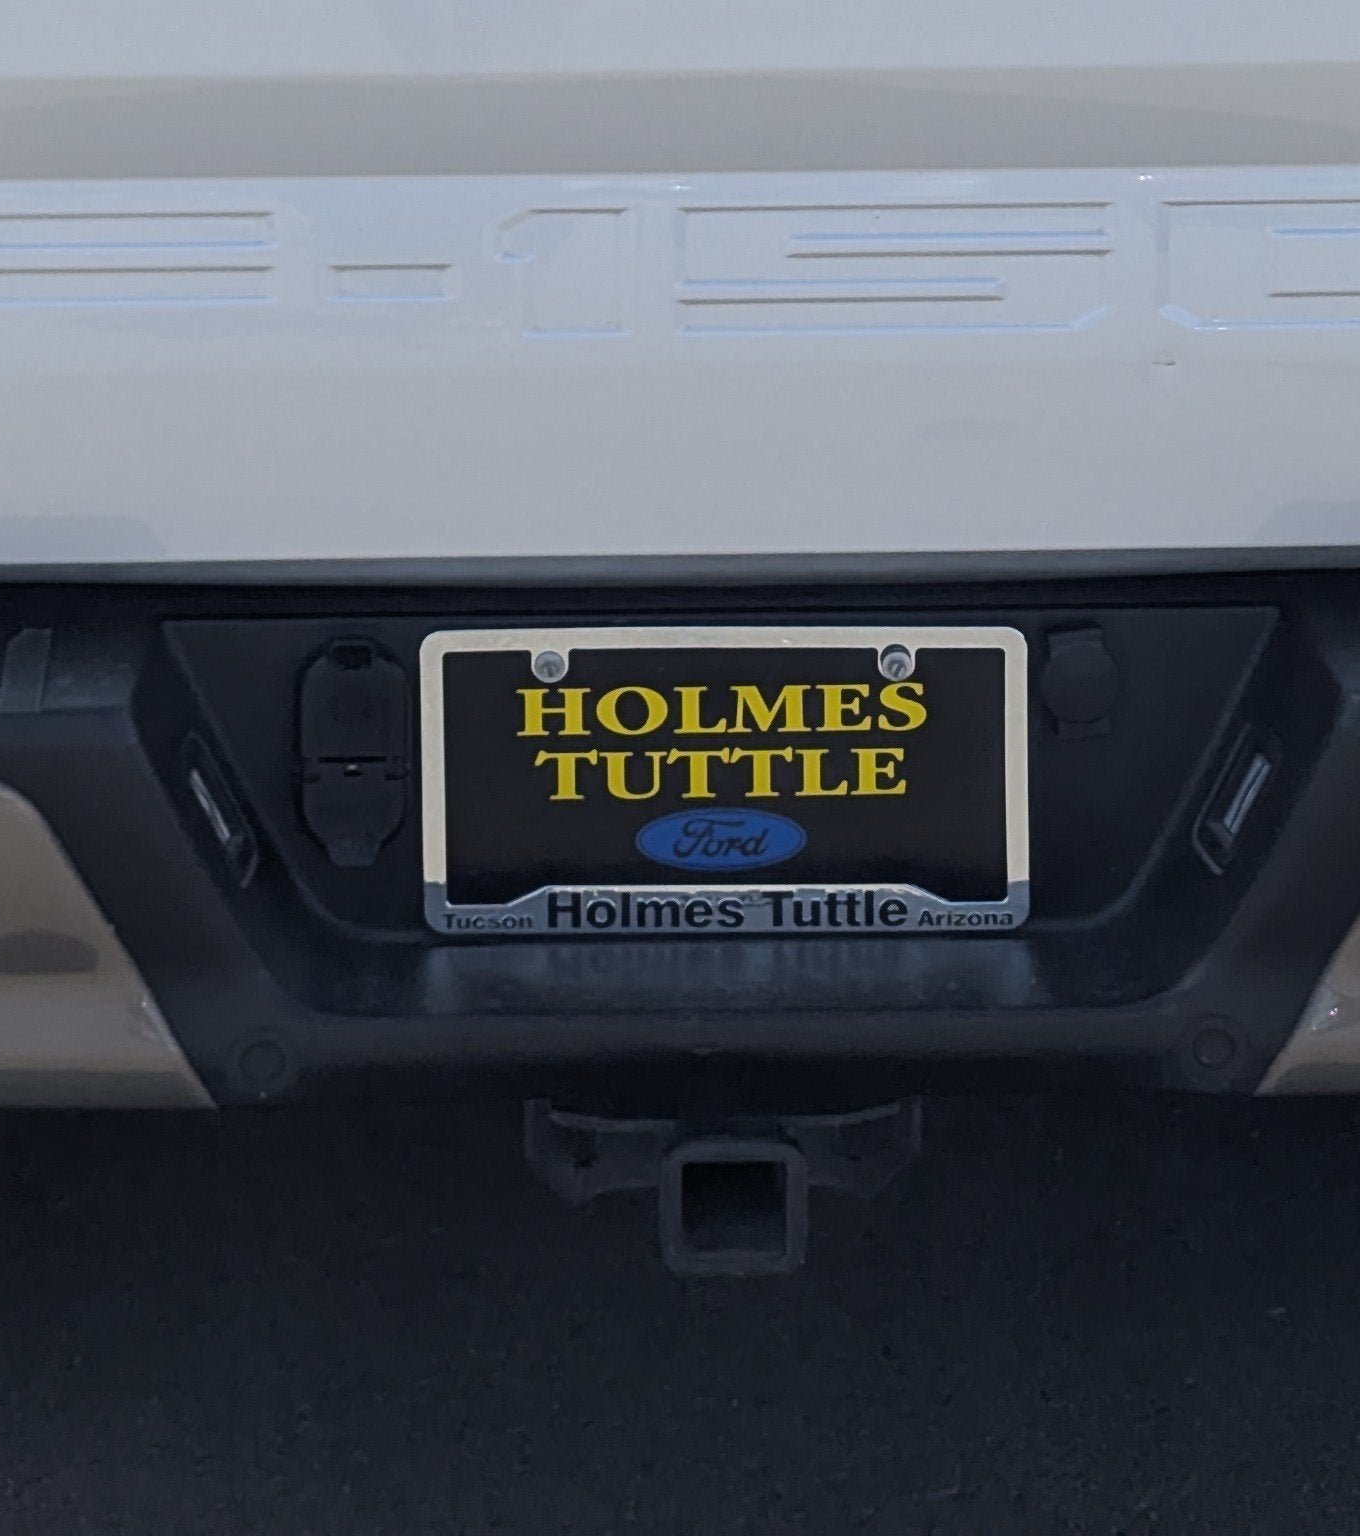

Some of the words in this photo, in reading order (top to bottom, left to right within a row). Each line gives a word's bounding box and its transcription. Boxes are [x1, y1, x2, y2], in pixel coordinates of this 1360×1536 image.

[514, 681, 928, 737] HOLMES
[534, 745, 907, 801] TUTTLE
[672, 817, 770, 859] Ford
[443, 913, 533, 930] Tucson
[547, 891, 746, 929] Holmes
[761, 889, 909, 928] Tuttle
[917, 910, 1014, 928] Arizona
